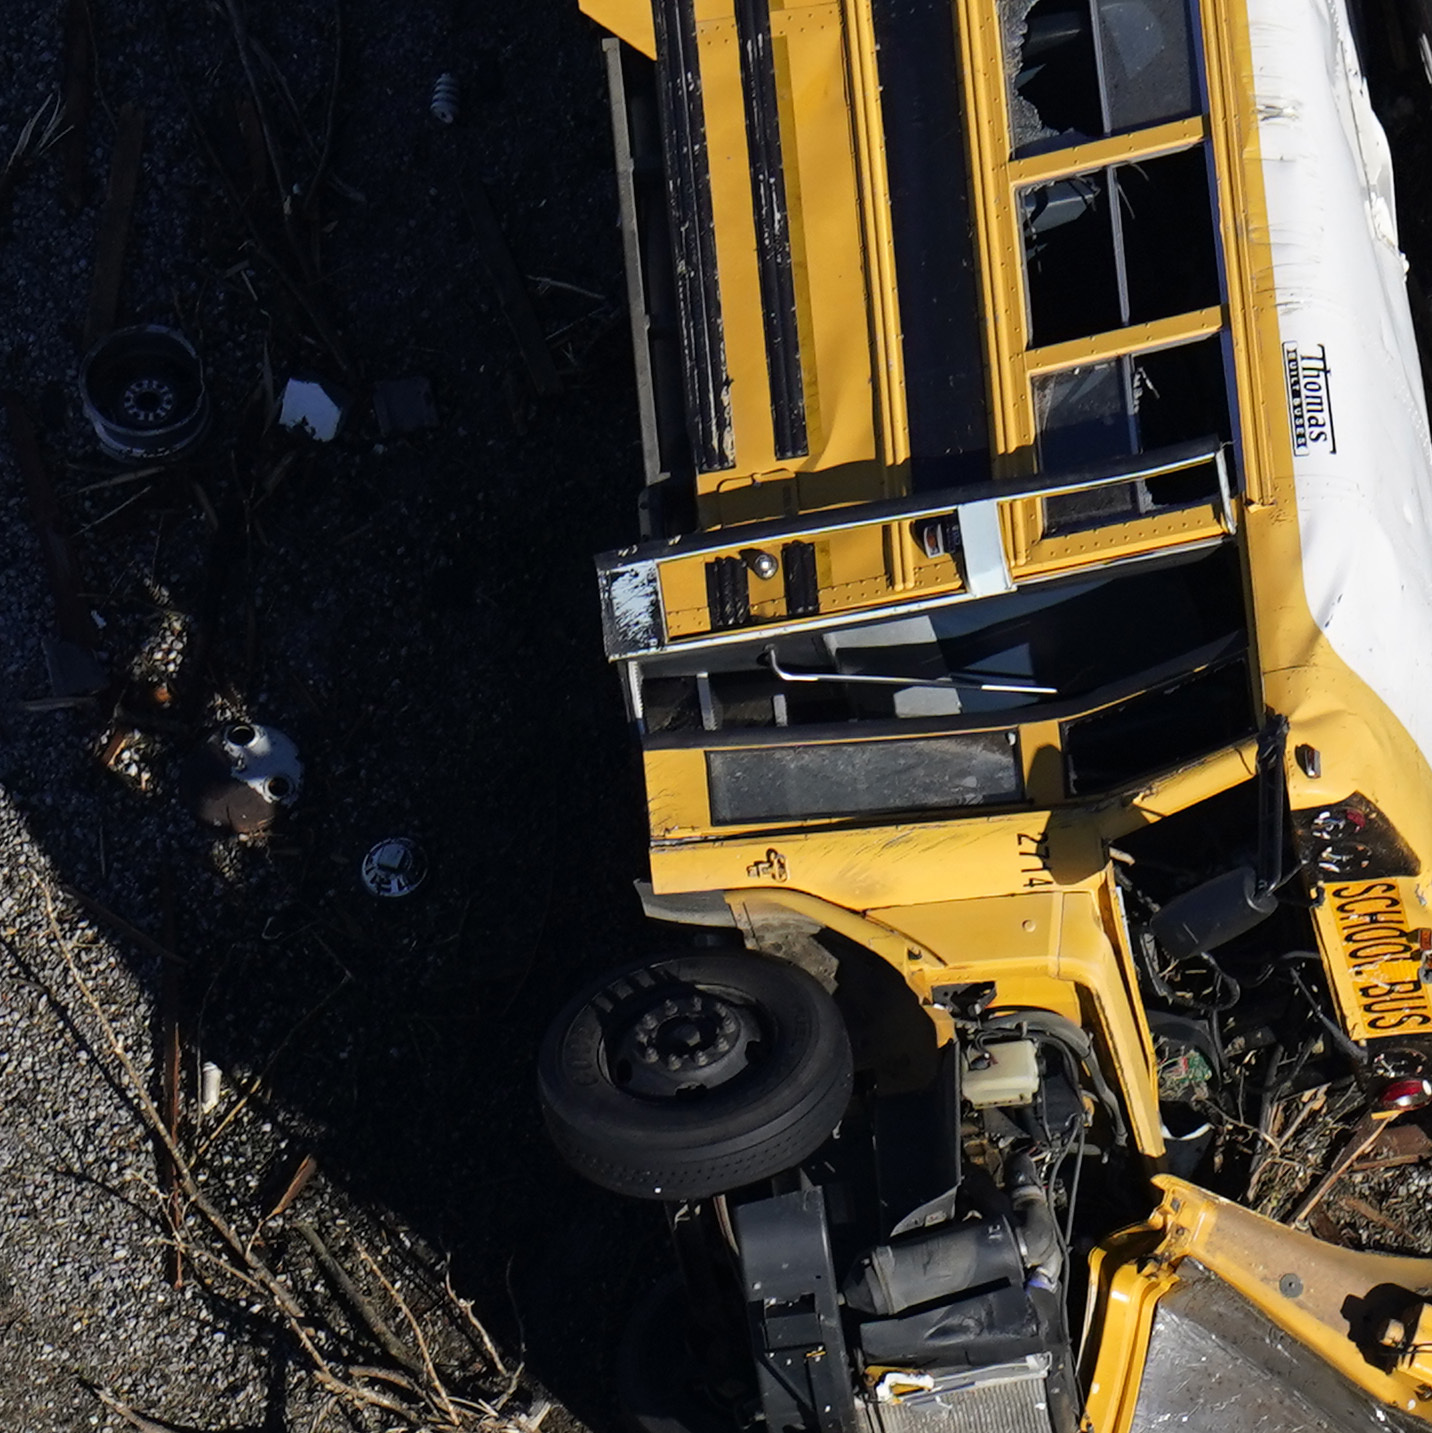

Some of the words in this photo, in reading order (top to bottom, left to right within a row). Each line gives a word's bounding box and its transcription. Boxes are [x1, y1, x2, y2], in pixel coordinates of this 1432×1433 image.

[1288, 351, 1301, 391] BUILT
[1293, 398, 1306, 445] BUSES
[1300, 344, 1337, 455] Thomas
[1017, 832, 1054, 888] 2714
[1332, 882, 1415, 976] SCHOOL
[1360, 980, 1431, 1030] BUS
